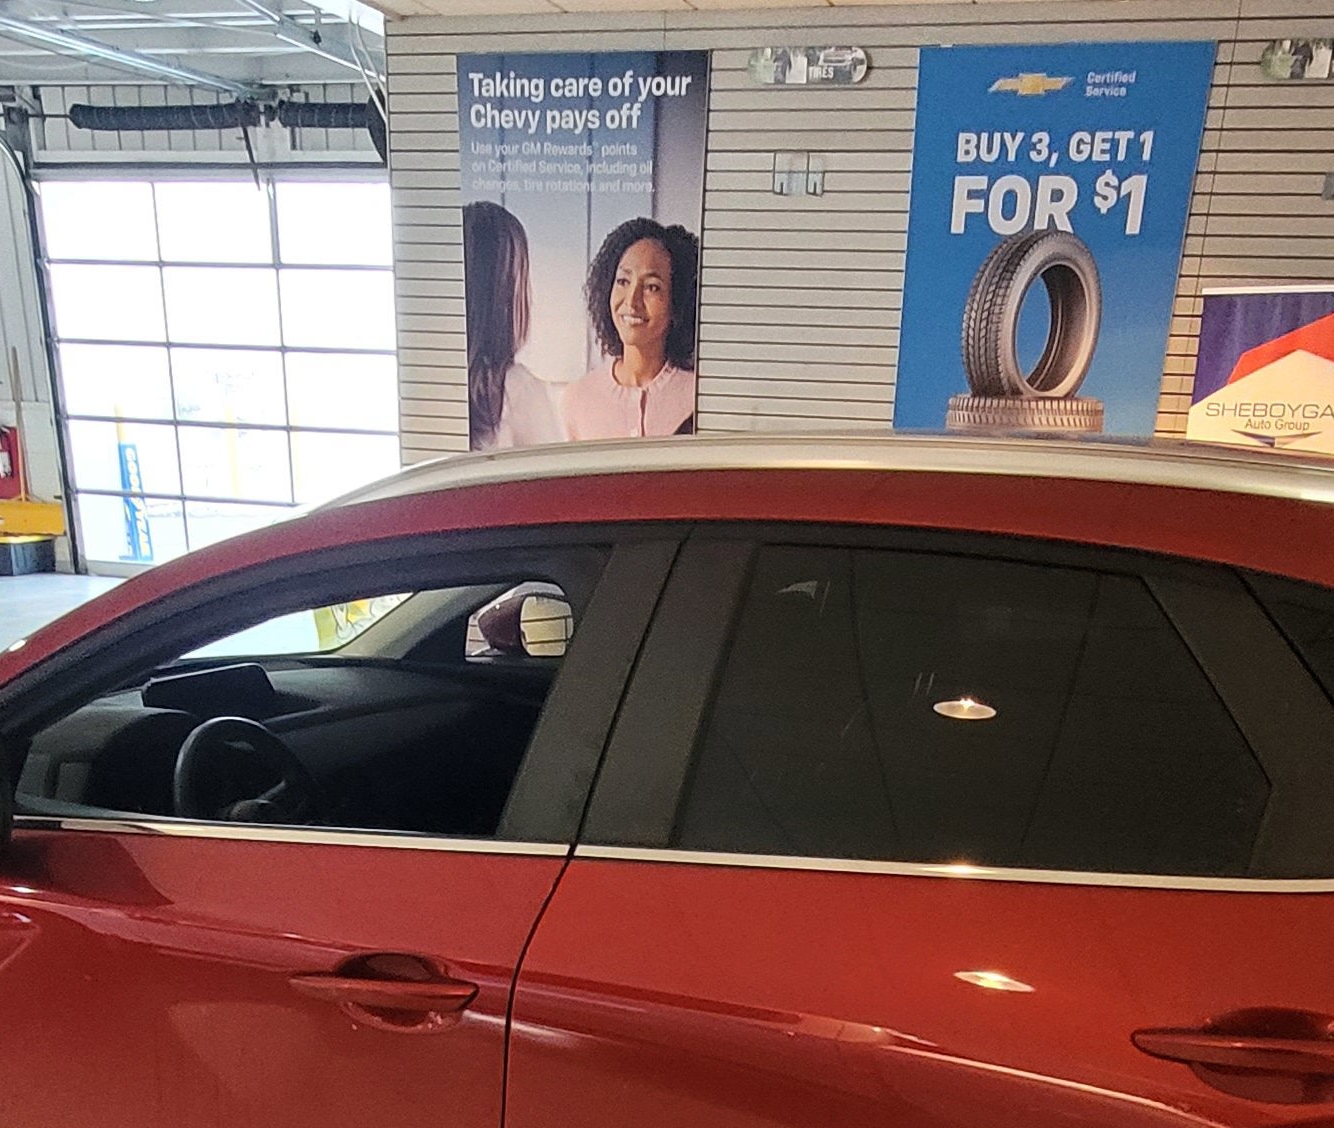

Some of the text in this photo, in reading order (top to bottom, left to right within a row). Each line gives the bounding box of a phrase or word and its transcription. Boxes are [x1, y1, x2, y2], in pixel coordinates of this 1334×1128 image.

[469, 70, 692, 102] Taking care of your
[1087, 71, 1136, 84] Certified
[1085, 86, 1127, 97] Service
[470, 102, 642, 135] Chevy pays off
[471, 142, 493, 154] Use
[495, 143, 519, 158] your
[521, 142, 541, 154] GM
[601, 143, 637, 157] points
[956, 130, 1155, 168] BUY 3, GET 1
[471, 159, 653, 177] on Certified Service, including oil
[523, 179, 543, 191] tire
[599, 179, 620, 192] and
[622, 181, 656, 193] more.
[950, 169, 1148, 236] FOR $1
[1244, 418, 1310, 431] Auto Group
